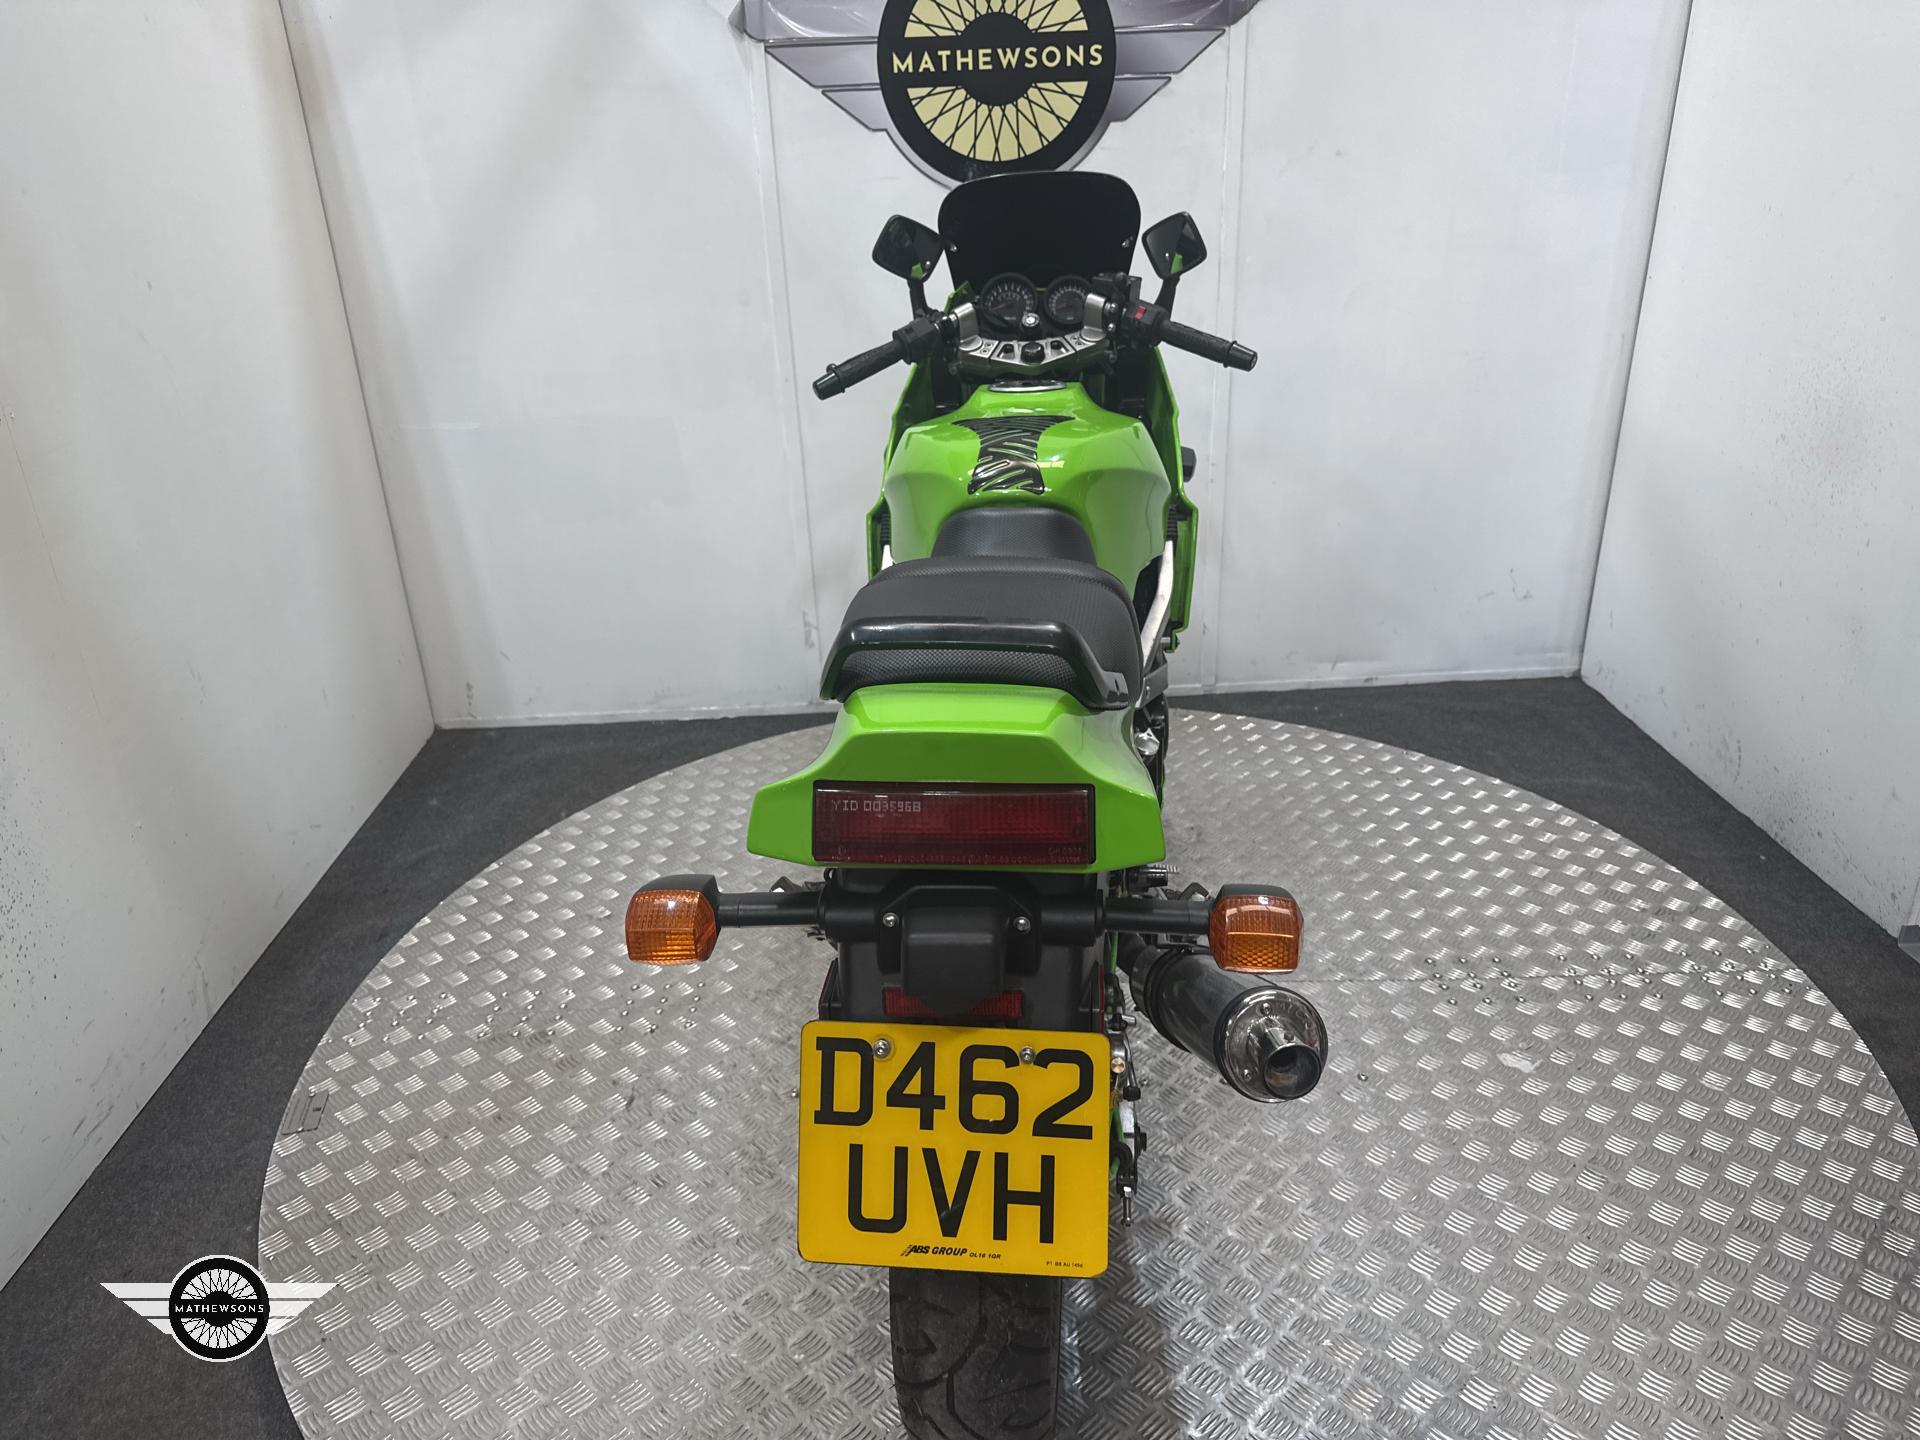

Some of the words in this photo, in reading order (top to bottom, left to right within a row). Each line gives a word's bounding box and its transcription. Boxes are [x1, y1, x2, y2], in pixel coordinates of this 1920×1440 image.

[892, 44, 1104, 74] MATHEWSONS
[813, 1035, 1094, 1141] D462
[847, 1143, 1056, 1244] UVH
[931, 1246, 968, 1257] GROUP
